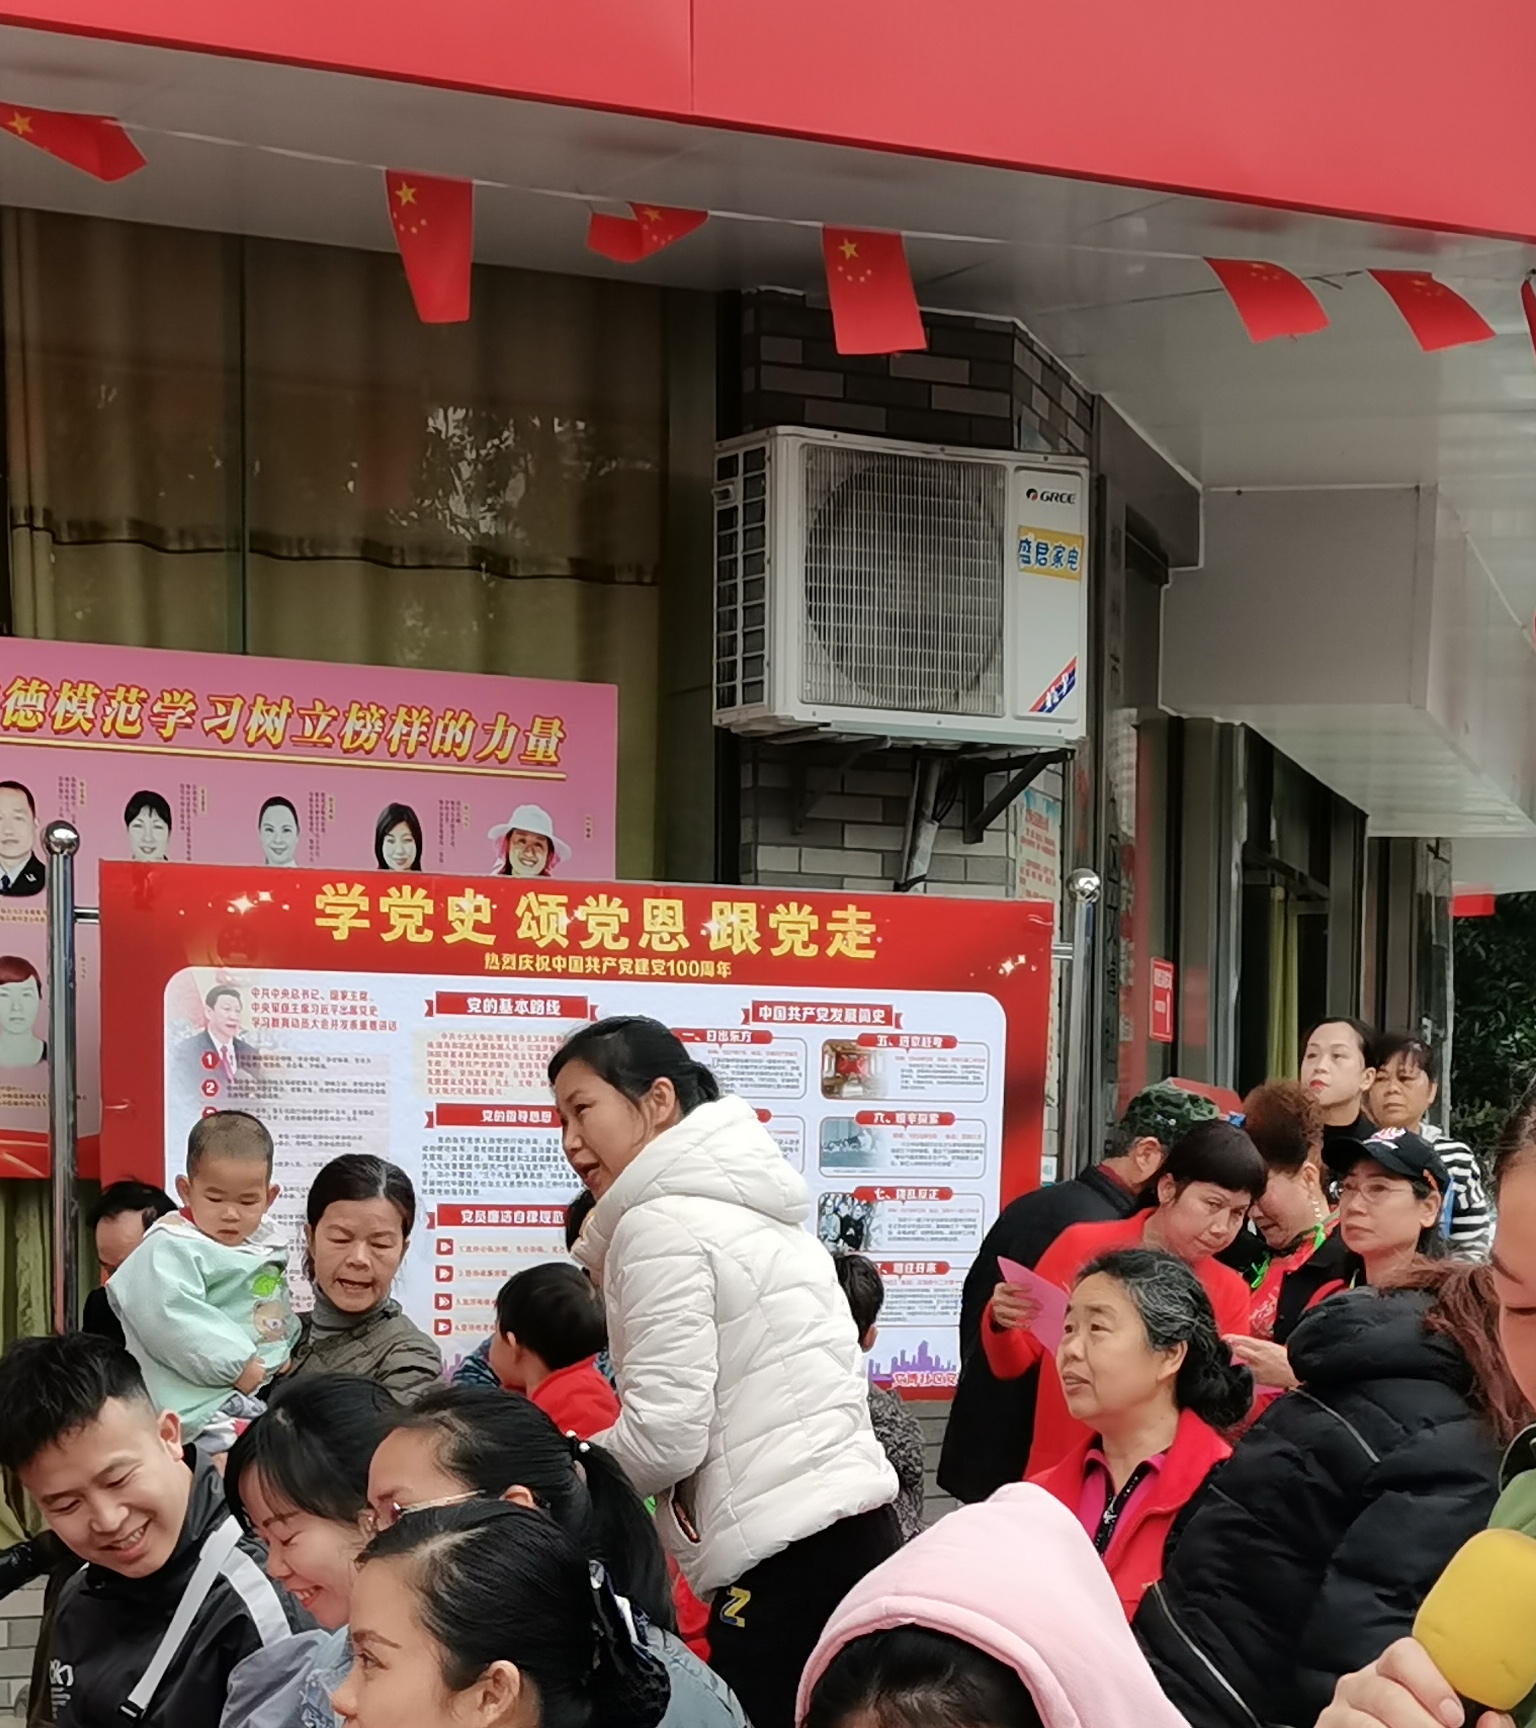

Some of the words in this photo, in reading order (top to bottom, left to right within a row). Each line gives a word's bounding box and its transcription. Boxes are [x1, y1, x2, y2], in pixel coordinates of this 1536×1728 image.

[313, 883, 497, 946] 学党史
[514, 890, 691, 952] 颂党恩
[708, 900, 879, 959] 跟党走
[483, 951, 733, 979] 热烈庆祝中国共产党建党100周年
[466, 997, 562, 1016] 党的基本路线
[757, 1004, 887, 1025] 中国共产党发展简史
